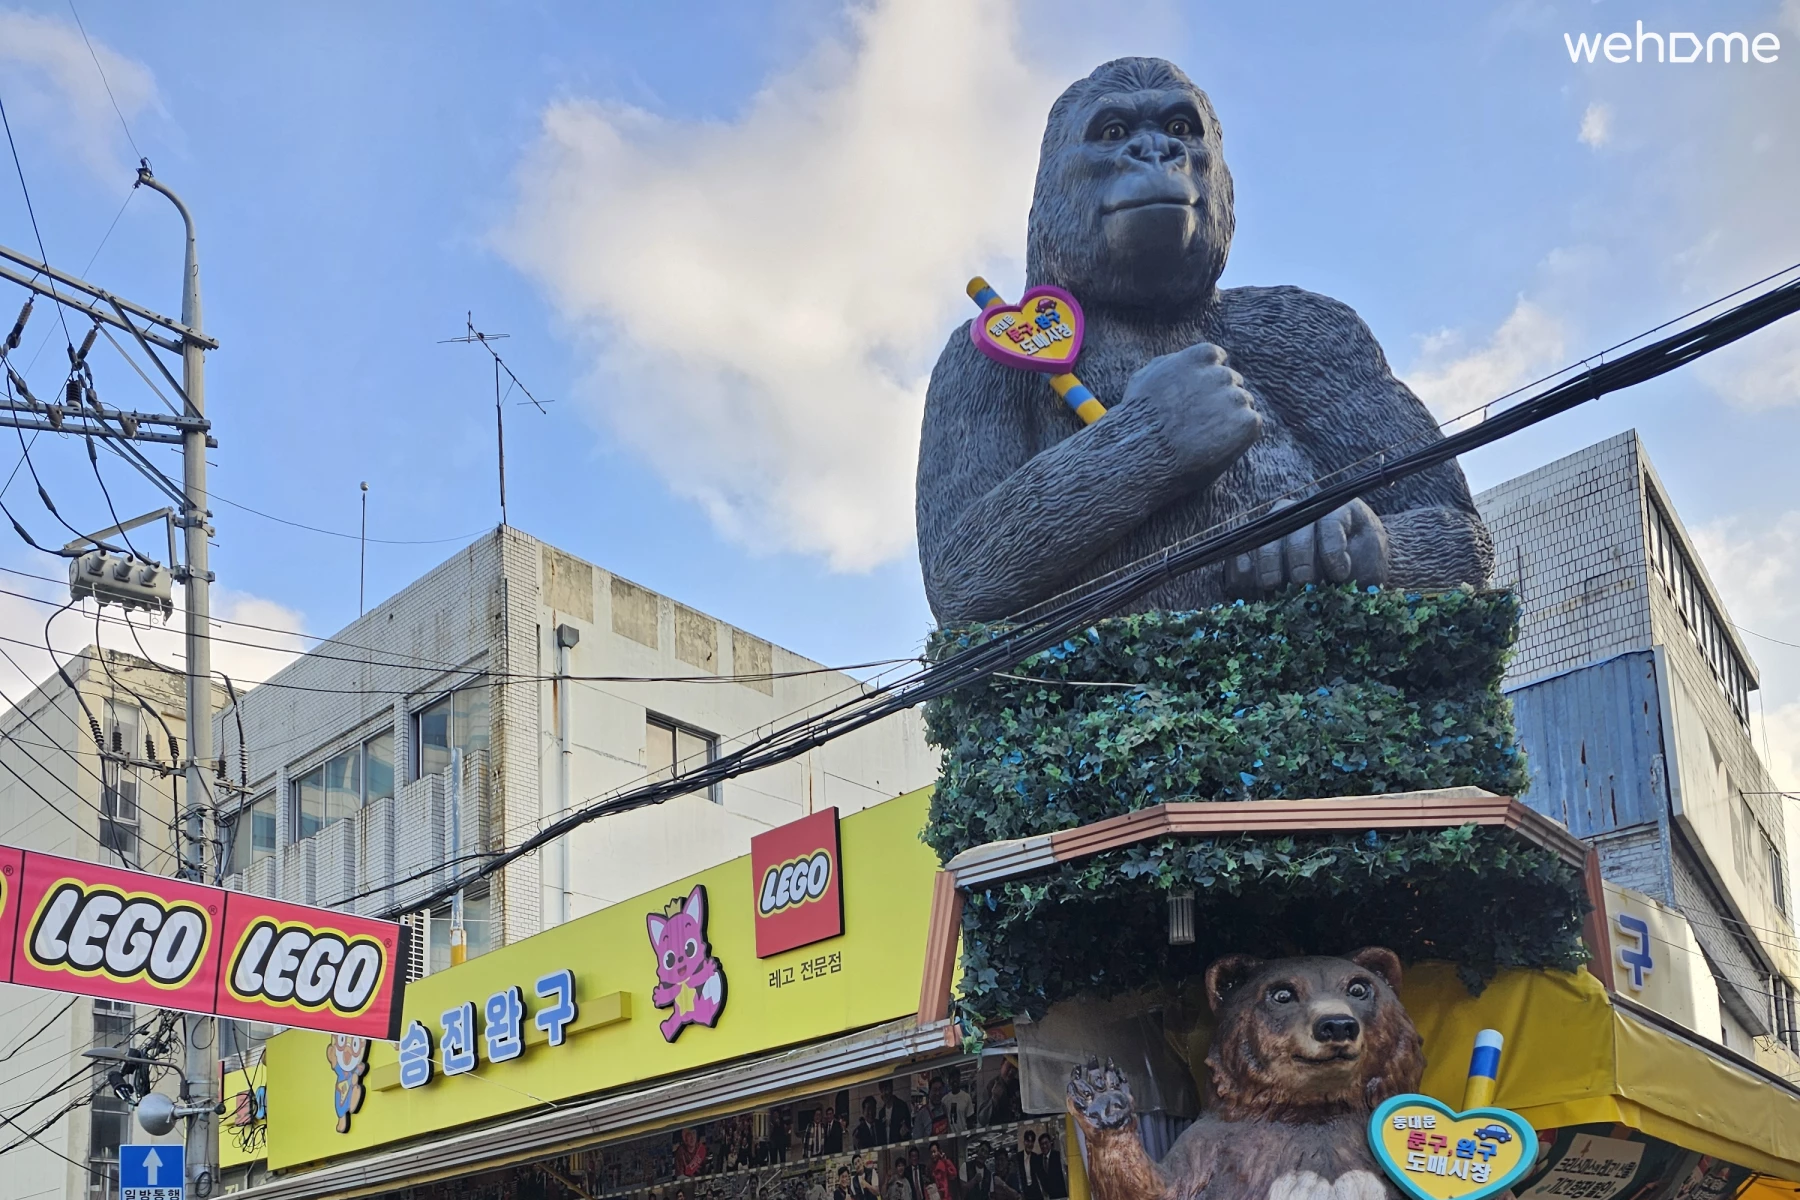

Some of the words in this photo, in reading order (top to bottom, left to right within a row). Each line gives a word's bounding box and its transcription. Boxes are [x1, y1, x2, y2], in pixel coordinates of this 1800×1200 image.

[1035, 309, 1061, 330] 완구
[1020, 323, 1073, 356] 도매시장
[760, 852, 830, 914] LEGO
[30, 883, 206, 984] LEGO
[230, 920, 383, 1012] LEGO
[1616, 913, 1655, 992] 구
[769, 967, 795, 988] 레고
[801, 951, 841, 981] 전문점
[399, 967, 577, 1090] 승진완구
[1393, 1115, 1436, 1130] 동대문
[1407, 1130, 1453, 1157] 문구,
[1456, 1138, 1497, 1162] 완구
[1405, 1151, 1492, 1183] 도매시장
[125, 1189, 179, 1200] 일방통행
